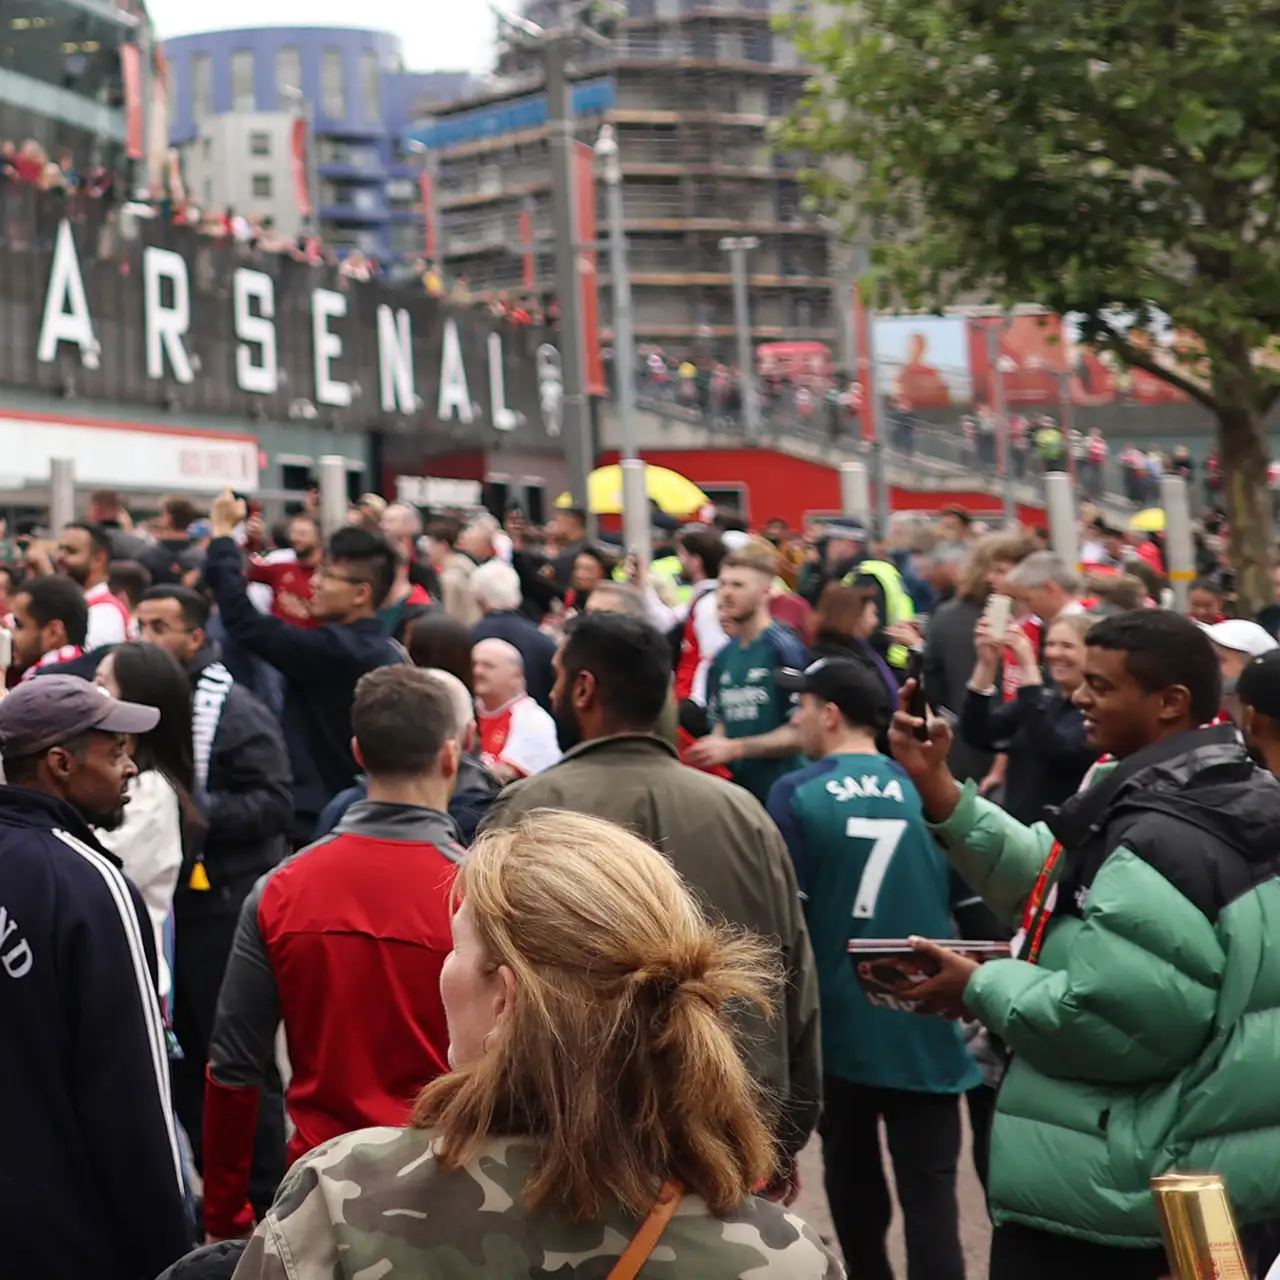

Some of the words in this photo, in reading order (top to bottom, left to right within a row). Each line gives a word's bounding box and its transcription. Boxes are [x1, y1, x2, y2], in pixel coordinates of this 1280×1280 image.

[38, 218, 518, 431] ARSENAL
[825, 774, 905, 803] SAKA
[845, 817, 908, 919] 7
